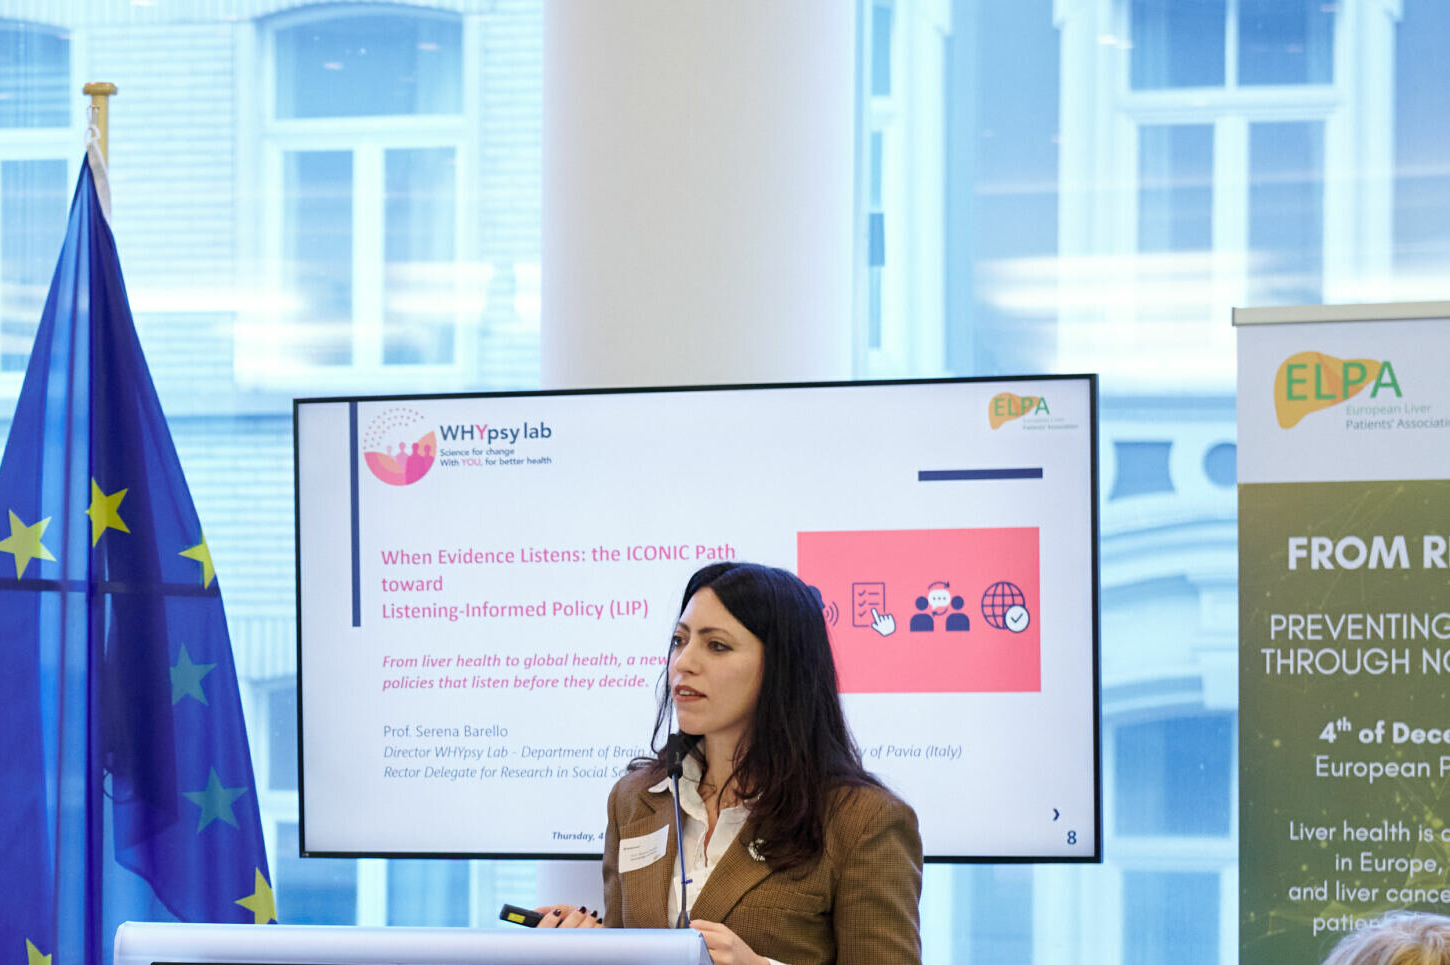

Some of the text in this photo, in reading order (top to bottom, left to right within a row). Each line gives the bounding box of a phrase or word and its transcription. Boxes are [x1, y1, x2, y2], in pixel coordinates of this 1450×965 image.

[1286, 361, 1403, 401] ELPA
[994, 396, 1050, 416] ELPA
[1345, 403, 1431, 415] European Liver
[439, 421, 552, 445] WHYpsy lab
[1345, 418, 1395, 430] Patients'
[440, 448, 515, 458] Science for change
[440, 458, 460, 467] With
[485, 458, 497, 466] for
[499, 457, 524, 466] better
[527, 456, 552, 465] health
[382, 543, 736, 565] When Evidence Listens: the ICONIC Path
[1288, 534, 1450, 570] FROM R
[382, 575, 443, 592] toward
[382, 599, 649, 621] Listening-Informed Policy (LIP)
[1270, 612, 1450, 640] PREVENTING
[382, 652, 667, 669] From liver health to global health, a new
[1261, 647, 1410, 676] THROUGH
[382, 674, 649, 692] policies that listen before they decide.
[384, 725, 508, 737] Prof. Serena Barello
[1319, 716, 1352, 744] 4th
[1358, 720, 1385, 744] of
[383, 746, 430, 758] Director
[435, 746, 483, 761] WHYpsy
[487, 745, 508, 758] Lab
[521, 746, 594, 761] Department
[597, 745, 611, 760] of
[613, 745, 645, 758] Brain
[870, 745, 883, 759] of
[886, 745, 921, 758] Pavia
[925, 745, 963, 760] (Italy)
[384, 766, 421, 778] Rector
[424, 766, 477, 781] Delegate
[479, 766, 498, 781] for
[501, 766, 552, 778] Research
[557, 766, 568, 778] in
[572, 766, 607, 778] Social
[1316, 755, 1430, 784] European
[552, 831, 595, 842] Thursday,
[1067, 830, 1077, 845] 8
[1289, 820, 1337, 841] Liver
[1343, 819, 1411, 842] health
[1418, 824, 1434, 843] is
[1335, 851, 1443, 878] in Europe,
[1288, 880, 1328, 901] and
[1336, 880, 1379, 901] liver
